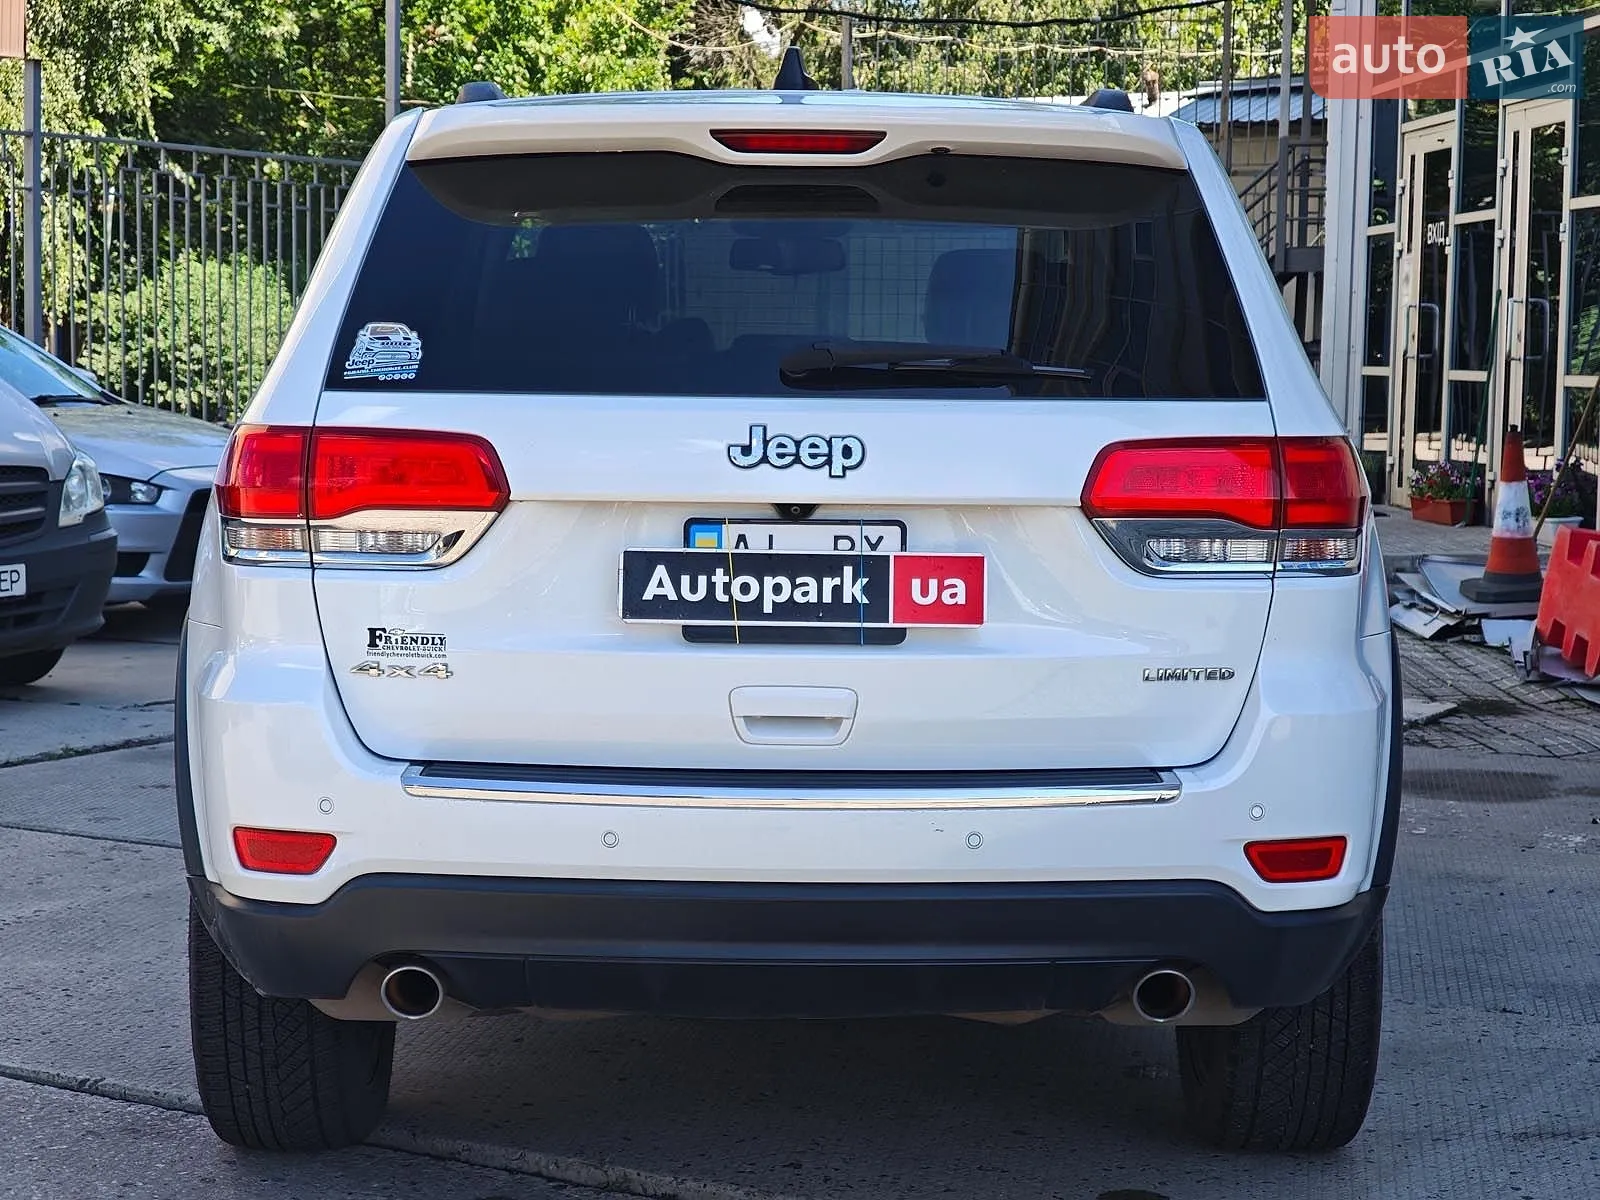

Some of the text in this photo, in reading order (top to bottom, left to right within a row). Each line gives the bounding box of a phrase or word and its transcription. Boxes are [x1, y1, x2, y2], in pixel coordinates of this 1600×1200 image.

[346, 359, 375, 367] Jeep
[728, 424, 866, 478] Jeep
[642, 565, 967, 613] Autopark ua
[1142, 667, 1235, 681] LIMITED
